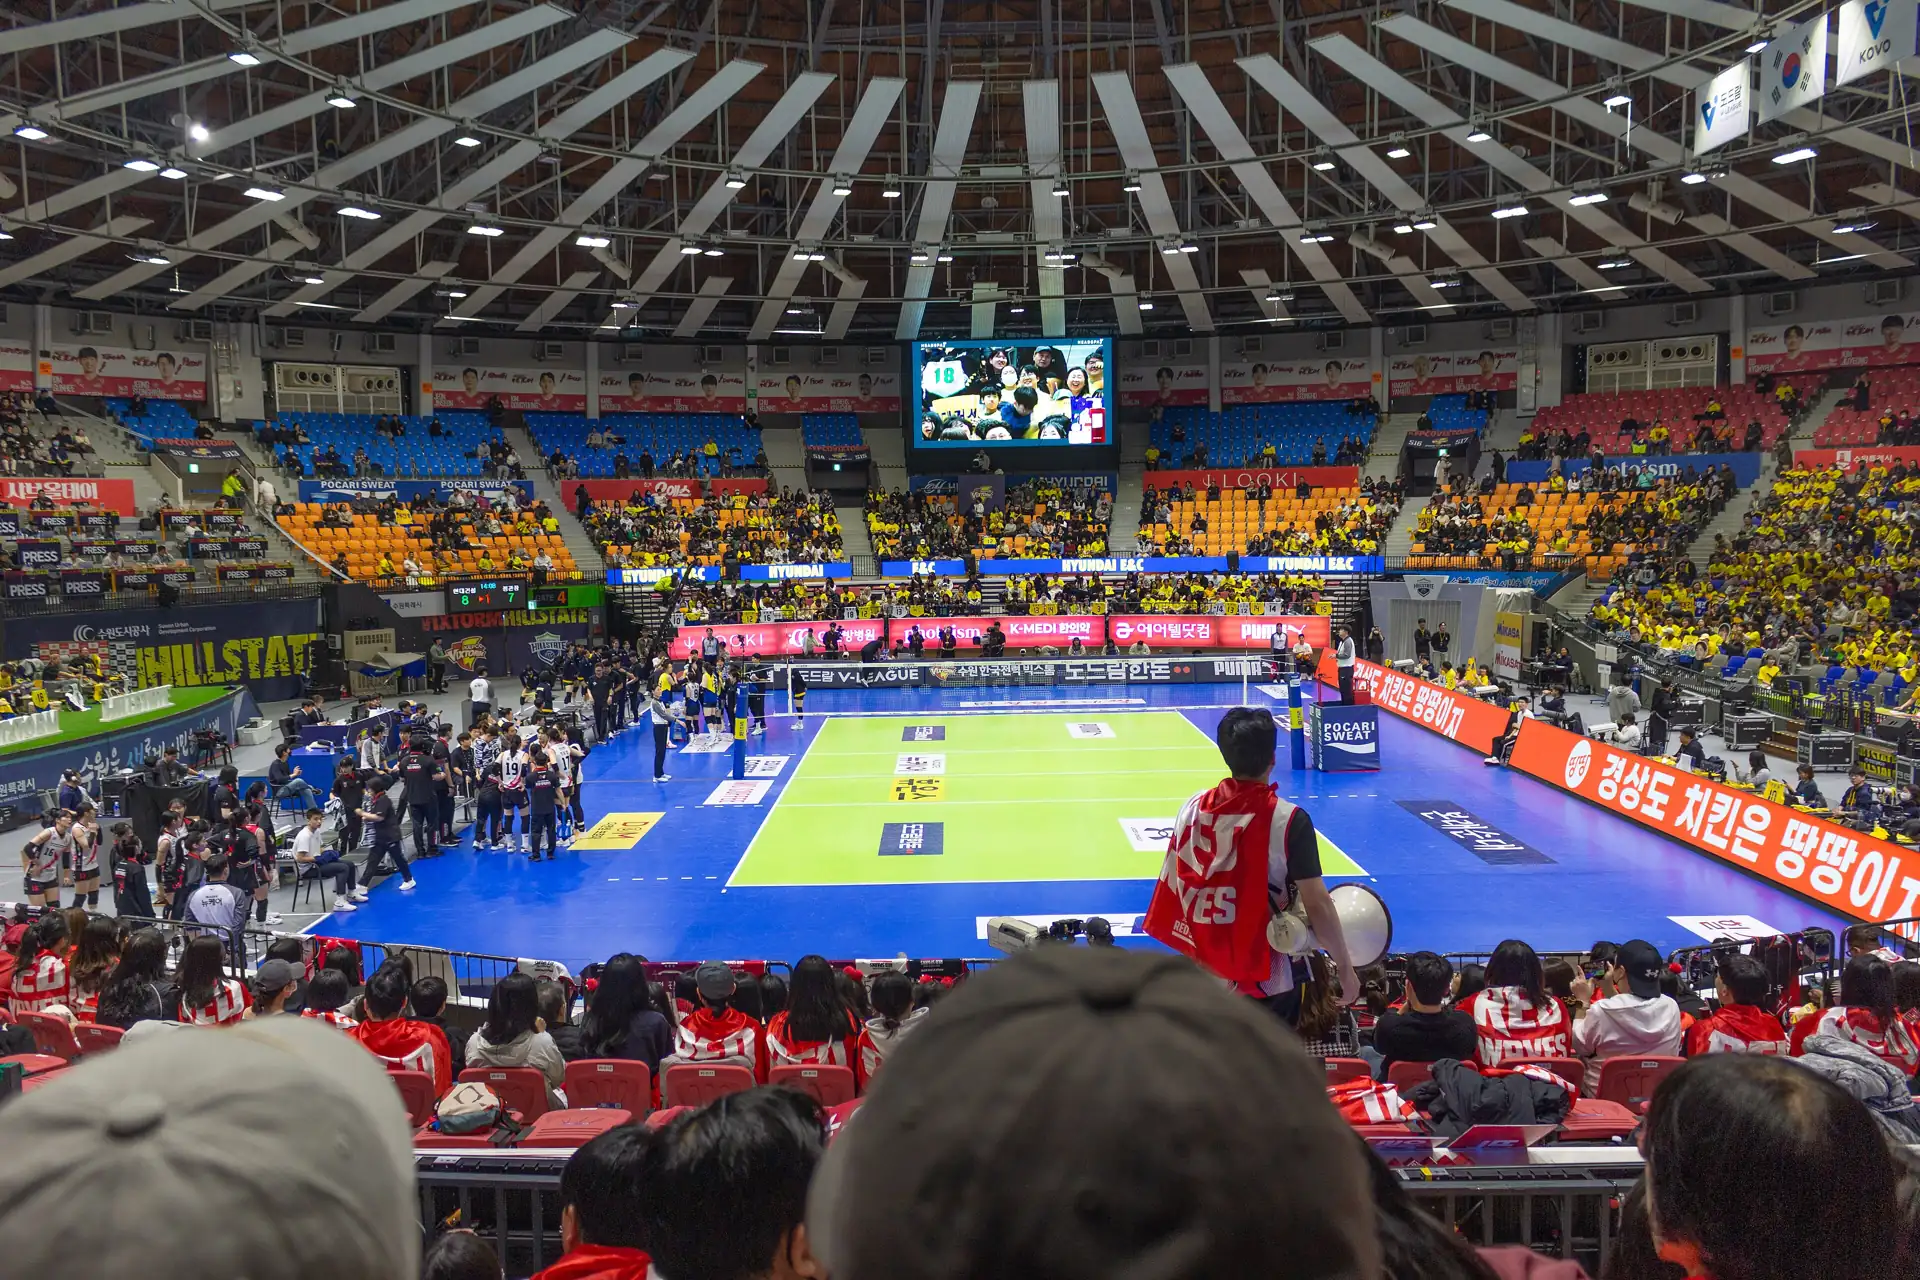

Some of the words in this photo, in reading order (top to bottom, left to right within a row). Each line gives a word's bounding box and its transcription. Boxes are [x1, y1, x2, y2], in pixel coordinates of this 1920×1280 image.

[1859, 39, 1891, 64] KOVO
[934, 367, 954, 384] 18
[1455, 437, 1469, 445] 517
[320, 481, 360, 489] POCARI
[361, 481, 396, 489] SWEAT
[441, 480, 478, 489] POCARI
[1223, 473, 1297, 488] LOOKI
[42, 517, 66, 526] PRESS
[88, 516, 112, 525] PRES
[213, 515, 235, 524] PRESS
[83, 546, 107, 554] PRESS
[125, 545, 149, 554] PRESS
[199, 542, 222, 551] PRESS
[239, 542, 261, 550] PRESS
[23, 551, 58, 563] PRESS
[912, 561, 935, 573] E&C
[1062, 559, 1116, 572] HYUNDAI
[1120, 558, 1144, 571] E&C
[1268, 557, 1325, 570] HYUNDAI
[1328, 557, 1354, 570] E&C
[227, 571, 249, 579] PRESS
[265, 569, 287, 577] PRESS
[769, 564, 823, 578] HYUNDAI
[124, 574, 148, 583] PRESS
[164, 573, 188, 582] PRESS
[10, 583, 46, 597] PRESS
[66, 581, 100, 594] PRESS
[461, 595, 469, 605] 8
[485, 594, 491, 604] 1
[508, 593, 514, 602] 7
[557, 591, 566, 604] 4
[503, 608, 587, 626] HILLSTATE
[97, 624, 150, 640] 수원도시공사
[1009, 624, 1056, 634] K-MEDI
[1136, 622, 1210, 639] 에어텔닷컴
[1241, 623, 1277, 639] PUM
[1496, 623, 1520, 639] MIKASA
[530, 641, 569, 653] HILLSTATE
[143, 633, 318, 690] HILLSTAT
[1495, 652, 1520, 670] MIKASA
[957, 665, 978, 676] 수원
[979, 664, 1023, 676] 한국전력
[1024, 664, 1055, 676] 빅스톰
[1214, 660, 1262, 676] PUMA
[1378, 674, 1415, 713] 치킨은
[1412, 685, 1465, 739] 땅땅이지
[1324, 721, 1375, 732] POCARI
[1324, 731, 1370, 741] SWEAT
[506, 762, 518, 776] 19
[561, 757, 570, 771] 17
[1568, 755, 1590, 777] 땅땅
[1598, 753, 1676, 822] 경상도
[1675, 783, 1771, 864] 치킨은
[44, 848, 54, 857] 16
[201, 898, 223, 908] 뉴케어
[1474, 985, 1562, 1037] RED
[1478, 1033, 1567, 1068] WAVES
